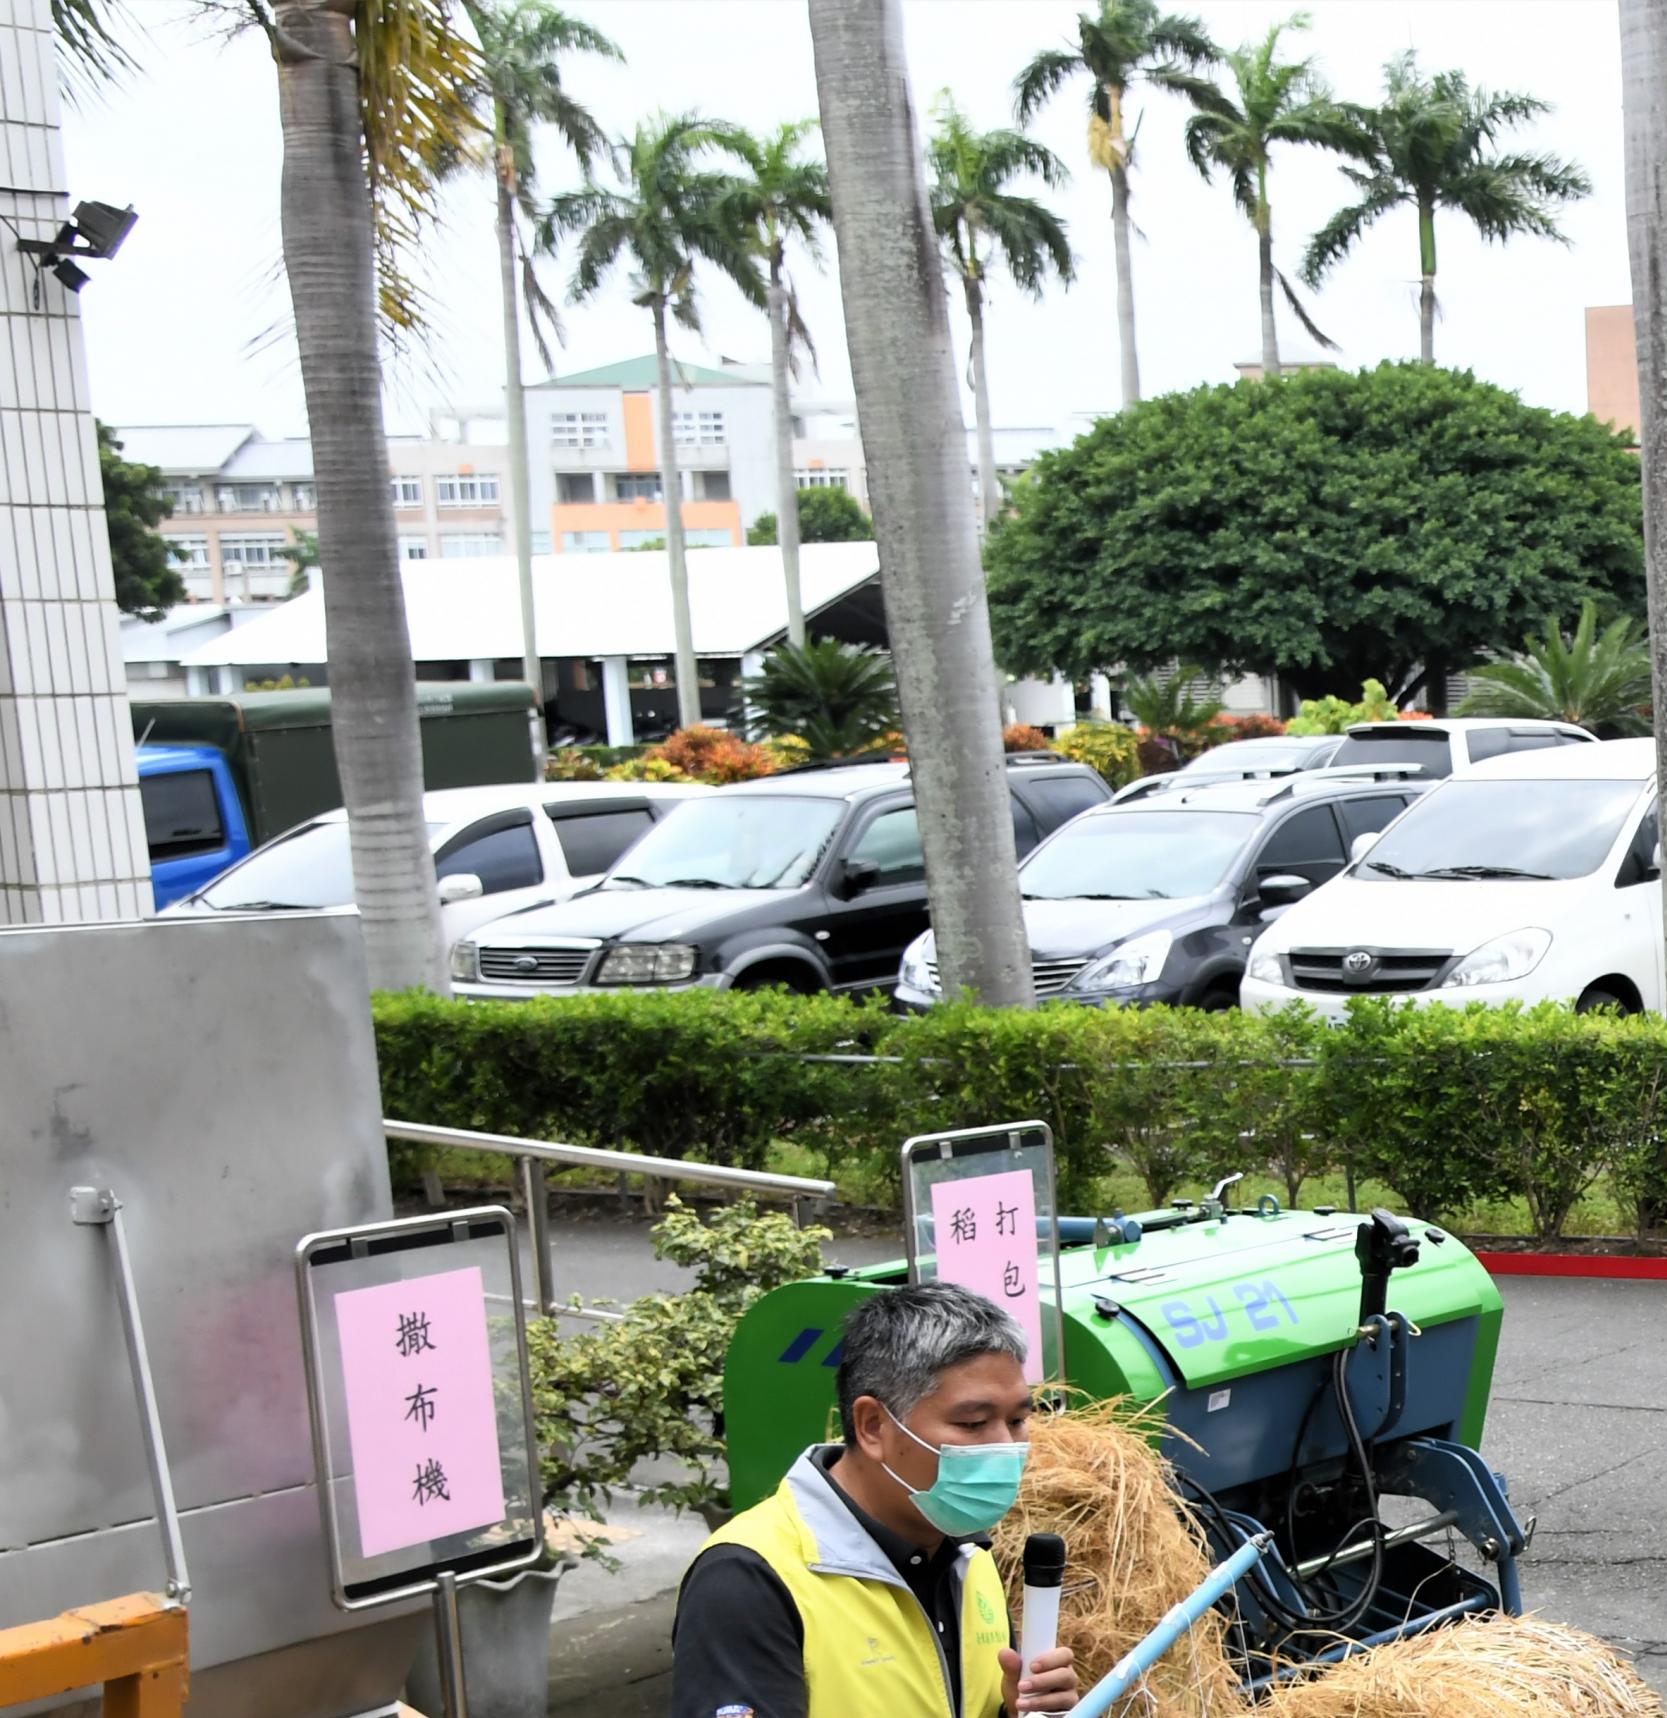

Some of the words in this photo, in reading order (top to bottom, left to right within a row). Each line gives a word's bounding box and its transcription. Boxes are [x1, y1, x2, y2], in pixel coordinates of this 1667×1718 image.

[994, 1200, 1027, 1299] 打包
[1160, 1295, 1229, 1350] SJ
[1232, 1279, 1300, 1333] 21
[394, 1310, 451, 1507] 撒布機
